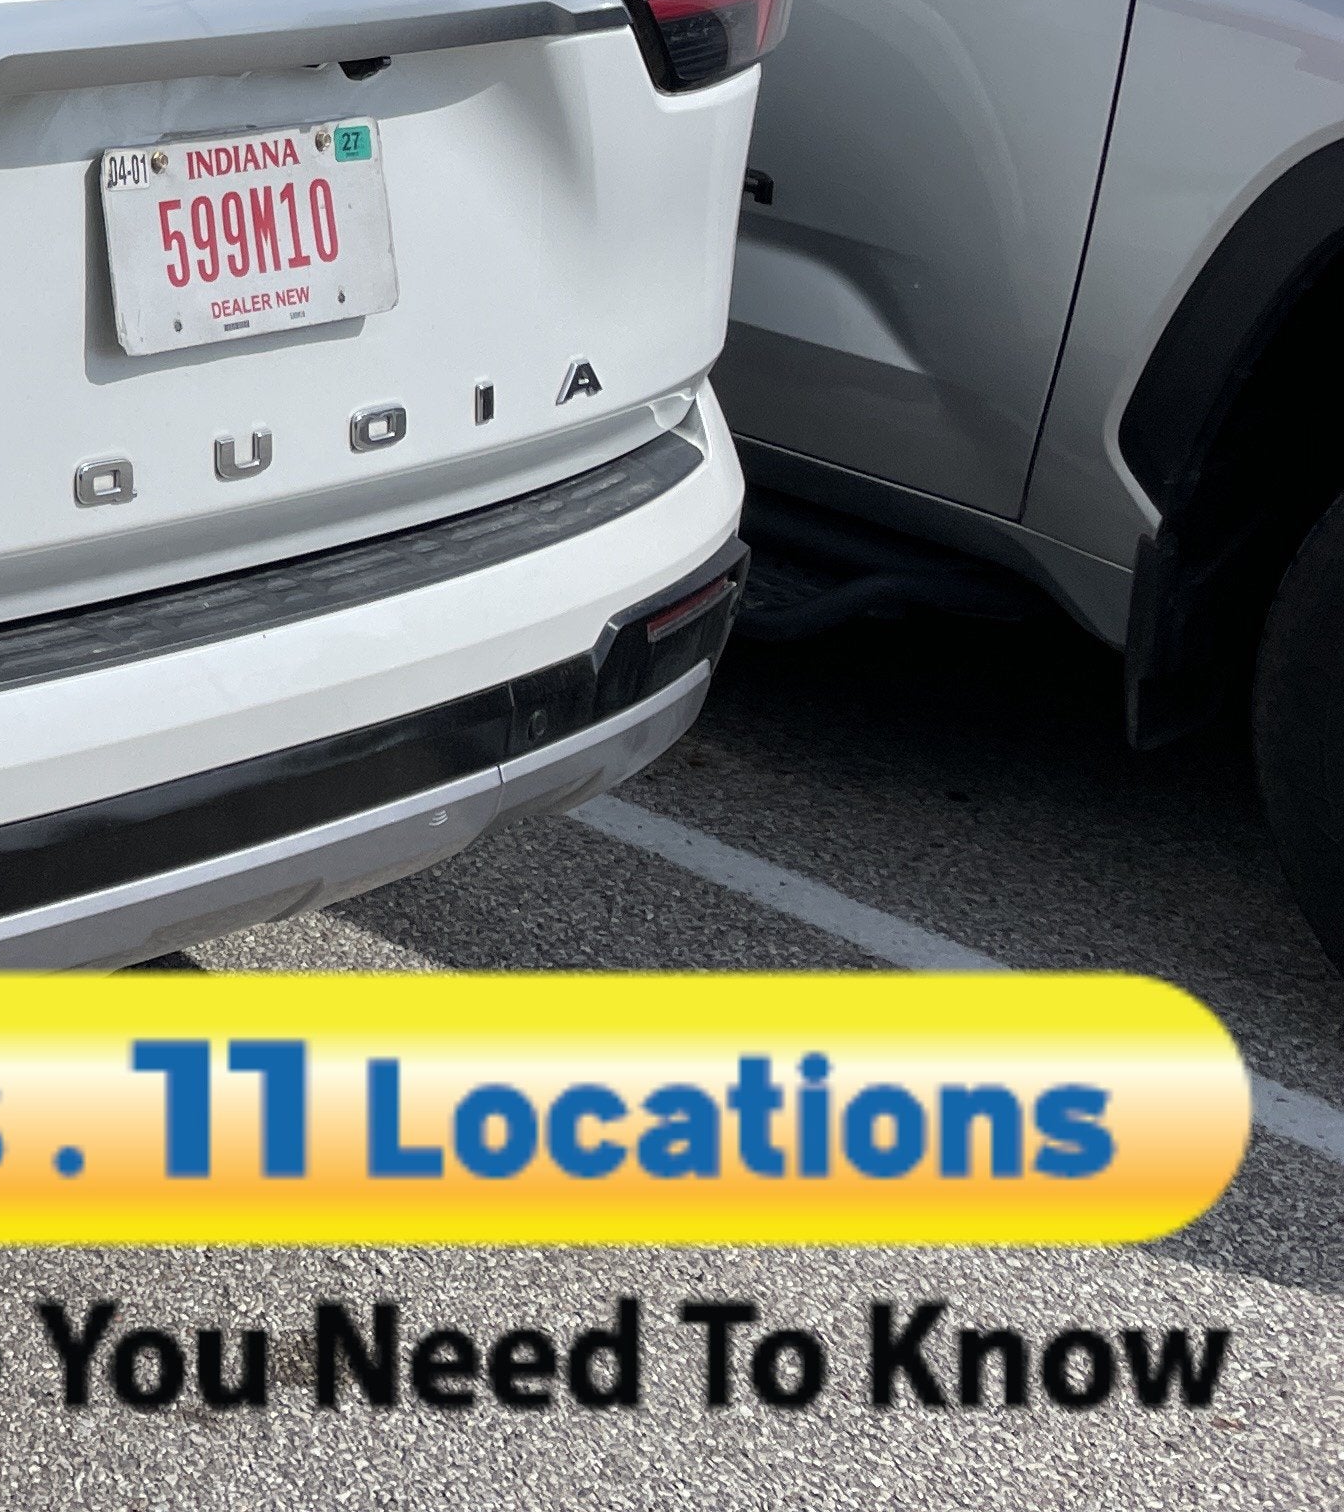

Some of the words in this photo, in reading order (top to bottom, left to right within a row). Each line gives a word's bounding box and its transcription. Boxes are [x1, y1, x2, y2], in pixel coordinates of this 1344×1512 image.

[186, 138, 301, 180] INDIANA
[341, 131, 361, 152] 27
[157, 178, 339, 288] 599M10
[211, 293, 273, 320] DEALER
[275, 286, 310, 308] NEW
